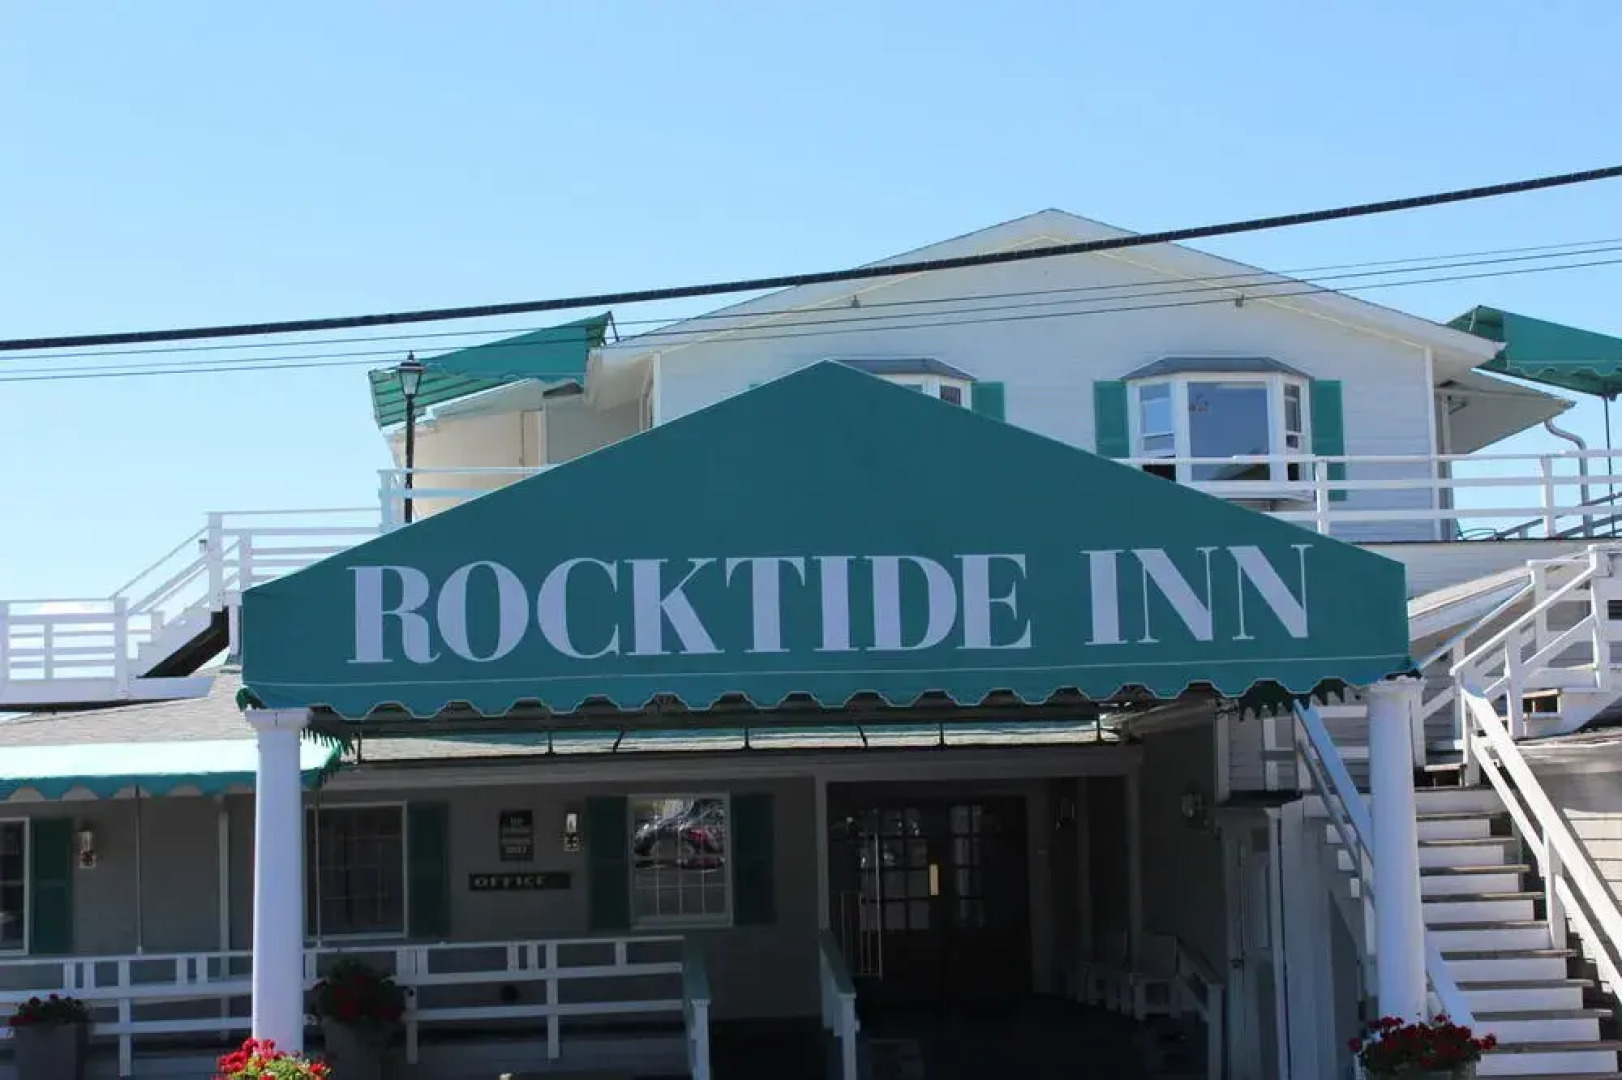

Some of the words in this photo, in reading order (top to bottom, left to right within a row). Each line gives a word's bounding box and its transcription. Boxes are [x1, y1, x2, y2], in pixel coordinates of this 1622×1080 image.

[347, 553, 1033, 664] ROCKTIDE
[1081, 543, 1311, 645] INN
[473, 875, 546, 888] OFFICE
